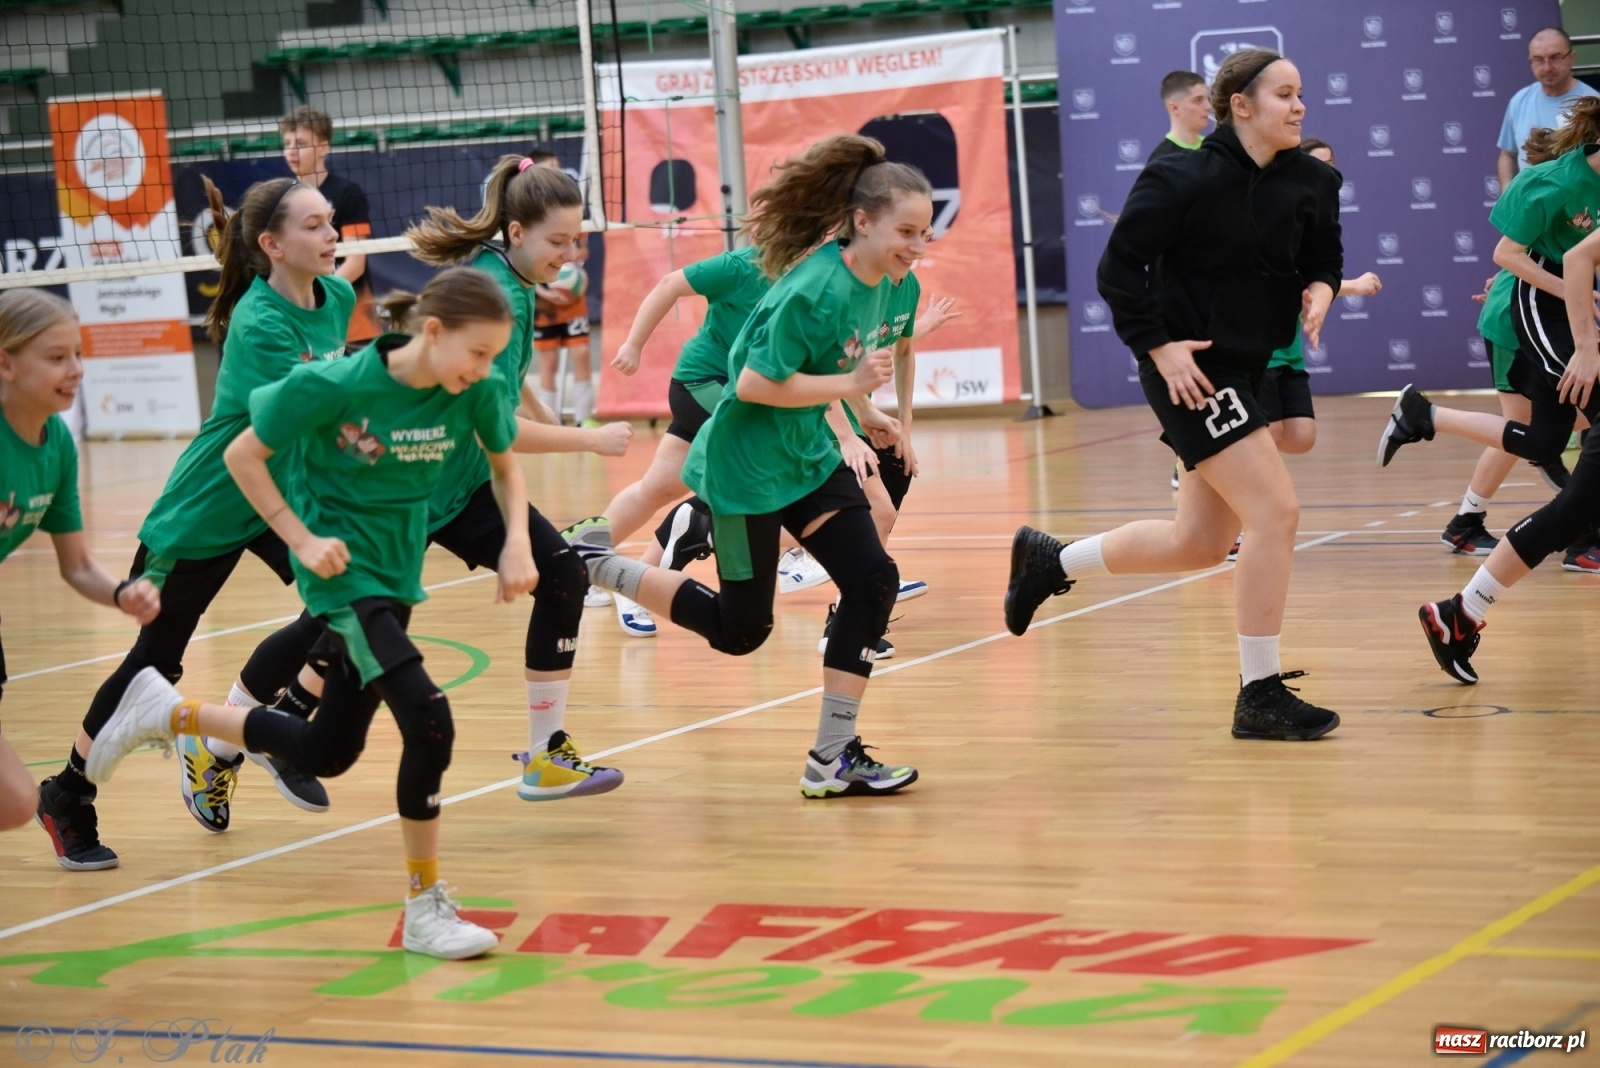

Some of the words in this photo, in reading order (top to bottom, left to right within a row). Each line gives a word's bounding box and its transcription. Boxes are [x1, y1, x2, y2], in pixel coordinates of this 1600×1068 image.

[655, 73, 700, 93] GRAJ
[703, 71, 714, 90] Z
[738, 59, 849, 88] STRZĘBSKIM
[854, 47, 944, 79] WĘGLEM!
[0, 237, 64, 272] RZ
[954, 380, 989, 400] JSW
[1196, 386, 1249, 439] 23
[390, 424, 446, 442] WYBIERZ
